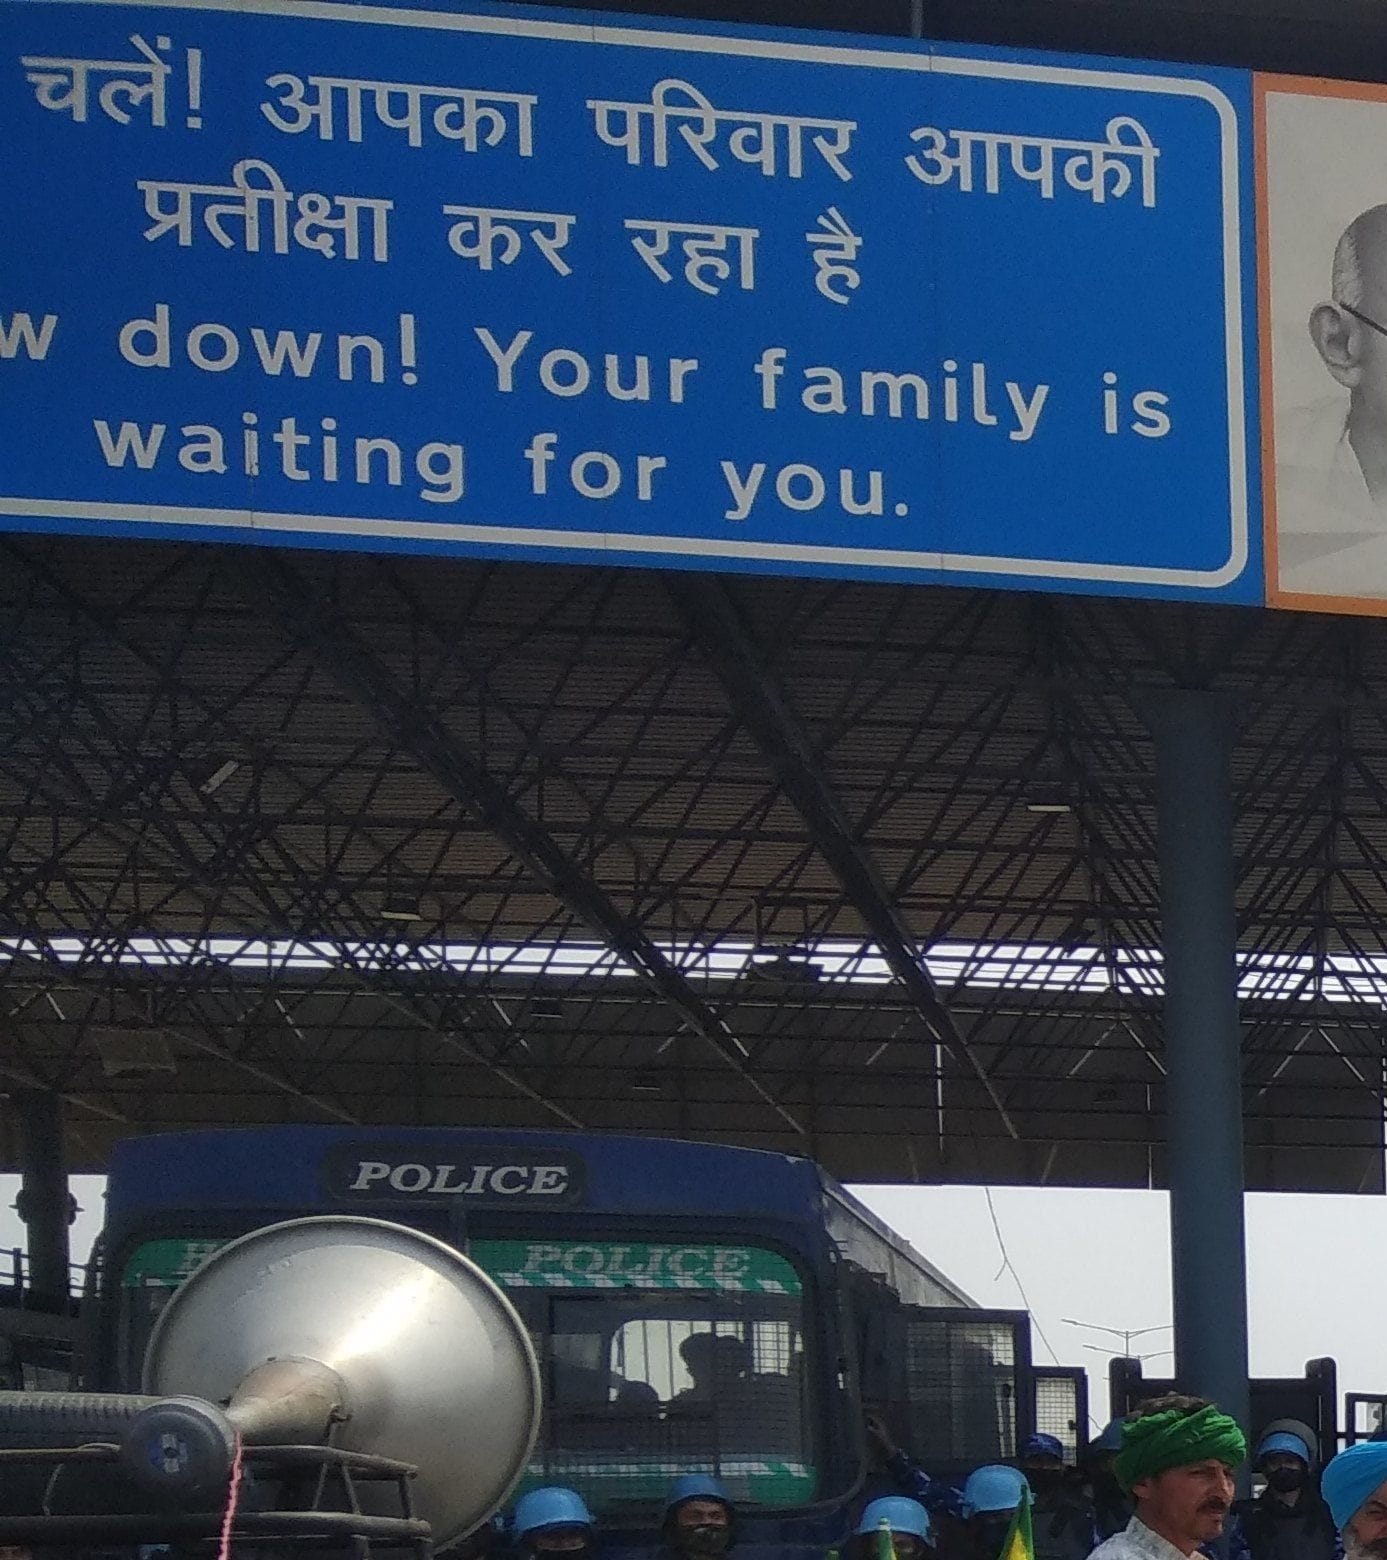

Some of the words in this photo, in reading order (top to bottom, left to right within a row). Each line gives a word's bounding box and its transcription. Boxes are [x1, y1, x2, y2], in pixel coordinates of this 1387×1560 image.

[22, 35, 203, 129] चलें!
[262, 75, 538, 157] आपका
[587, 79, 857, 182] परिवार
[906, 117, 1160, 208] आपकी
[138, 159, 393, 262] प्रतीक्षा
[444, 205, 576, 276] कर
[625, 219, 759, 295] रहा
[807, 208, 862, 305] है
[119, 304, 417, 385] down!
[475, 327, 698, 403] Your
[756, 348, 1051, 441] family
[1103, 372, 1172, 438] is
[95, 412, 466, 504] waiting
[525, 432, 668, 501] for
[721, 461, 909, 520] you.
[350, 1161, 568, 1196] POLICE
[521, 1244, 751, 1278] POLICE
